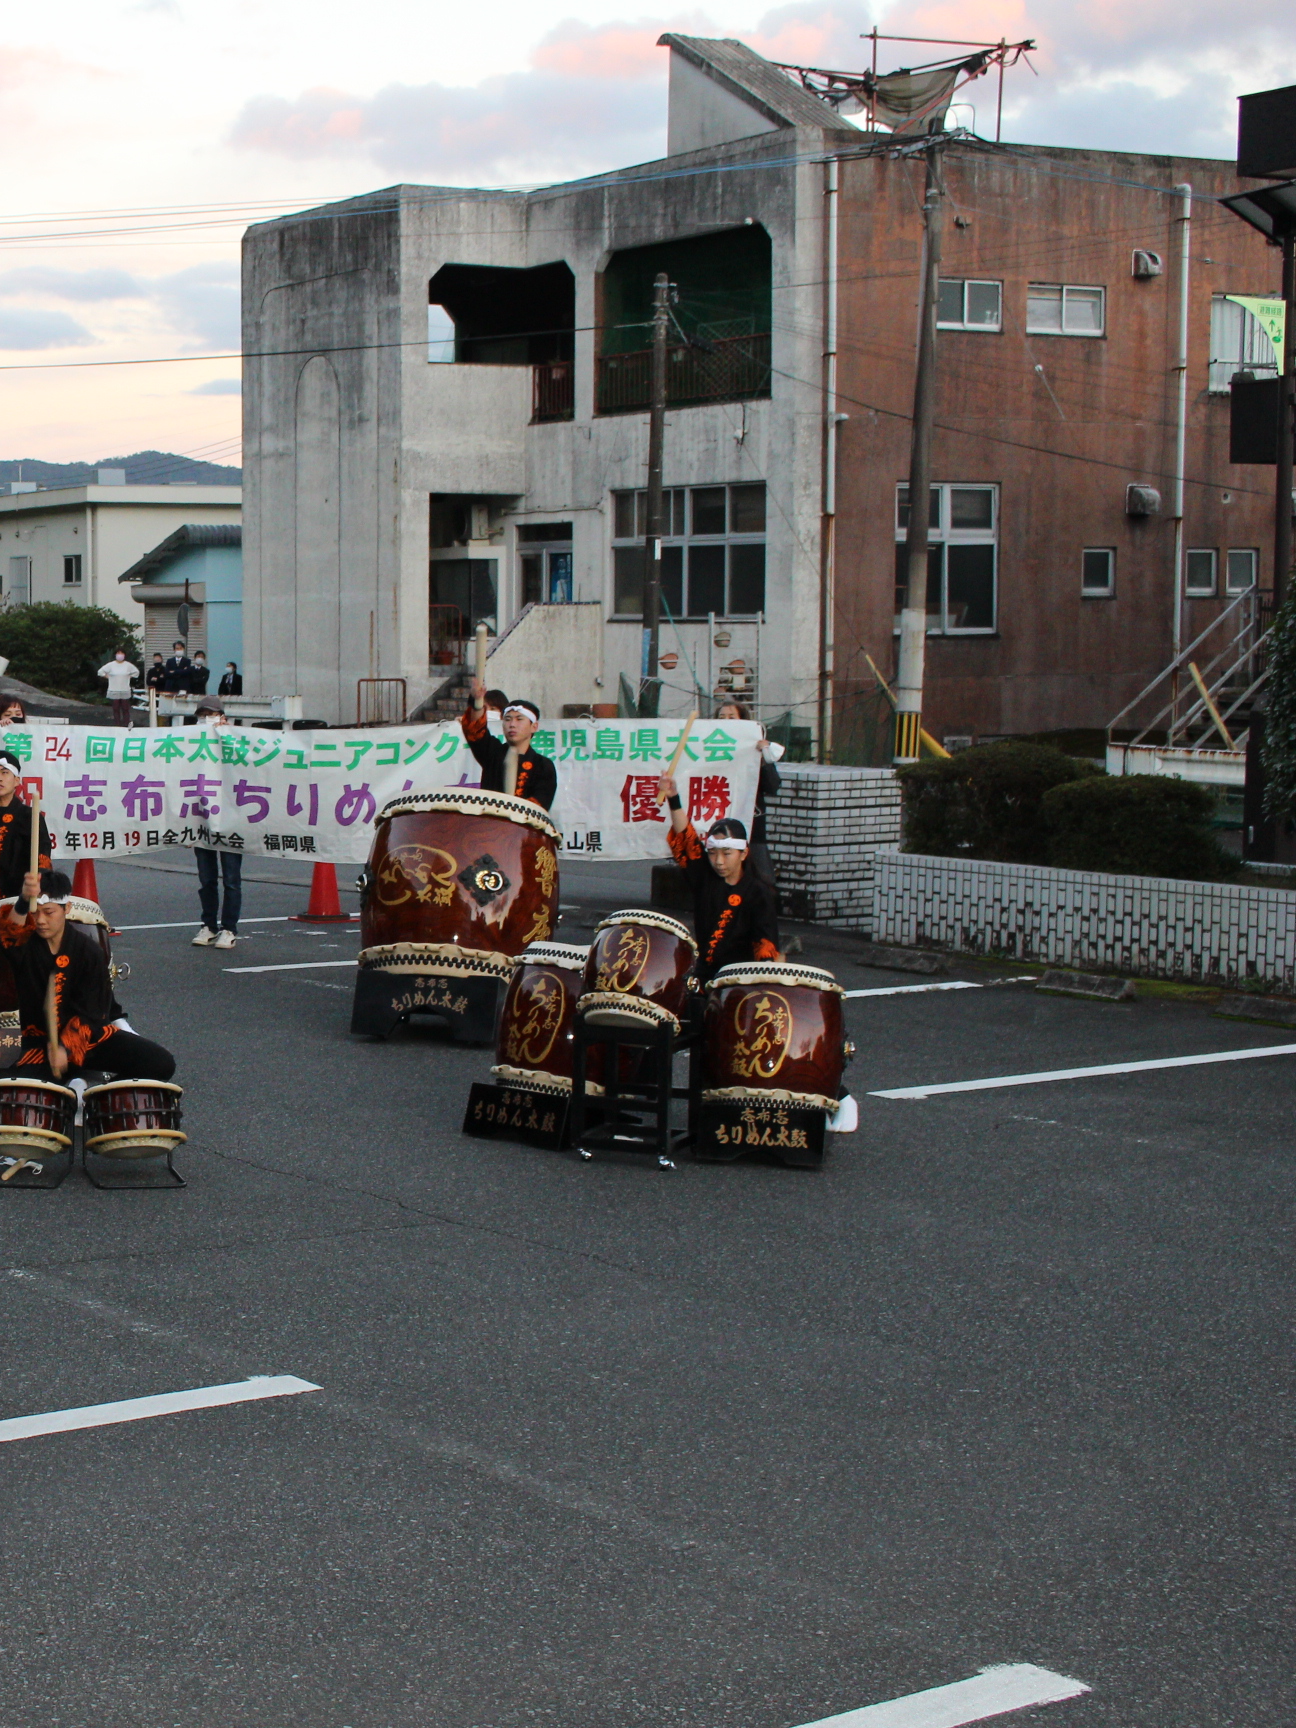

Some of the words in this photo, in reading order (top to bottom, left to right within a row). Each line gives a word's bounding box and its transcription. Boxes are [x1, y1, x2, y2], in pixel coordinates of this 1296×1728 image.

[263, 834, 316, 853] 福岡県
[558, 831, 603, 853] 山県
[740, 1107, 789, 1125] 志布志
[715, 1124, 808, 1148] ちりめん太鼓
